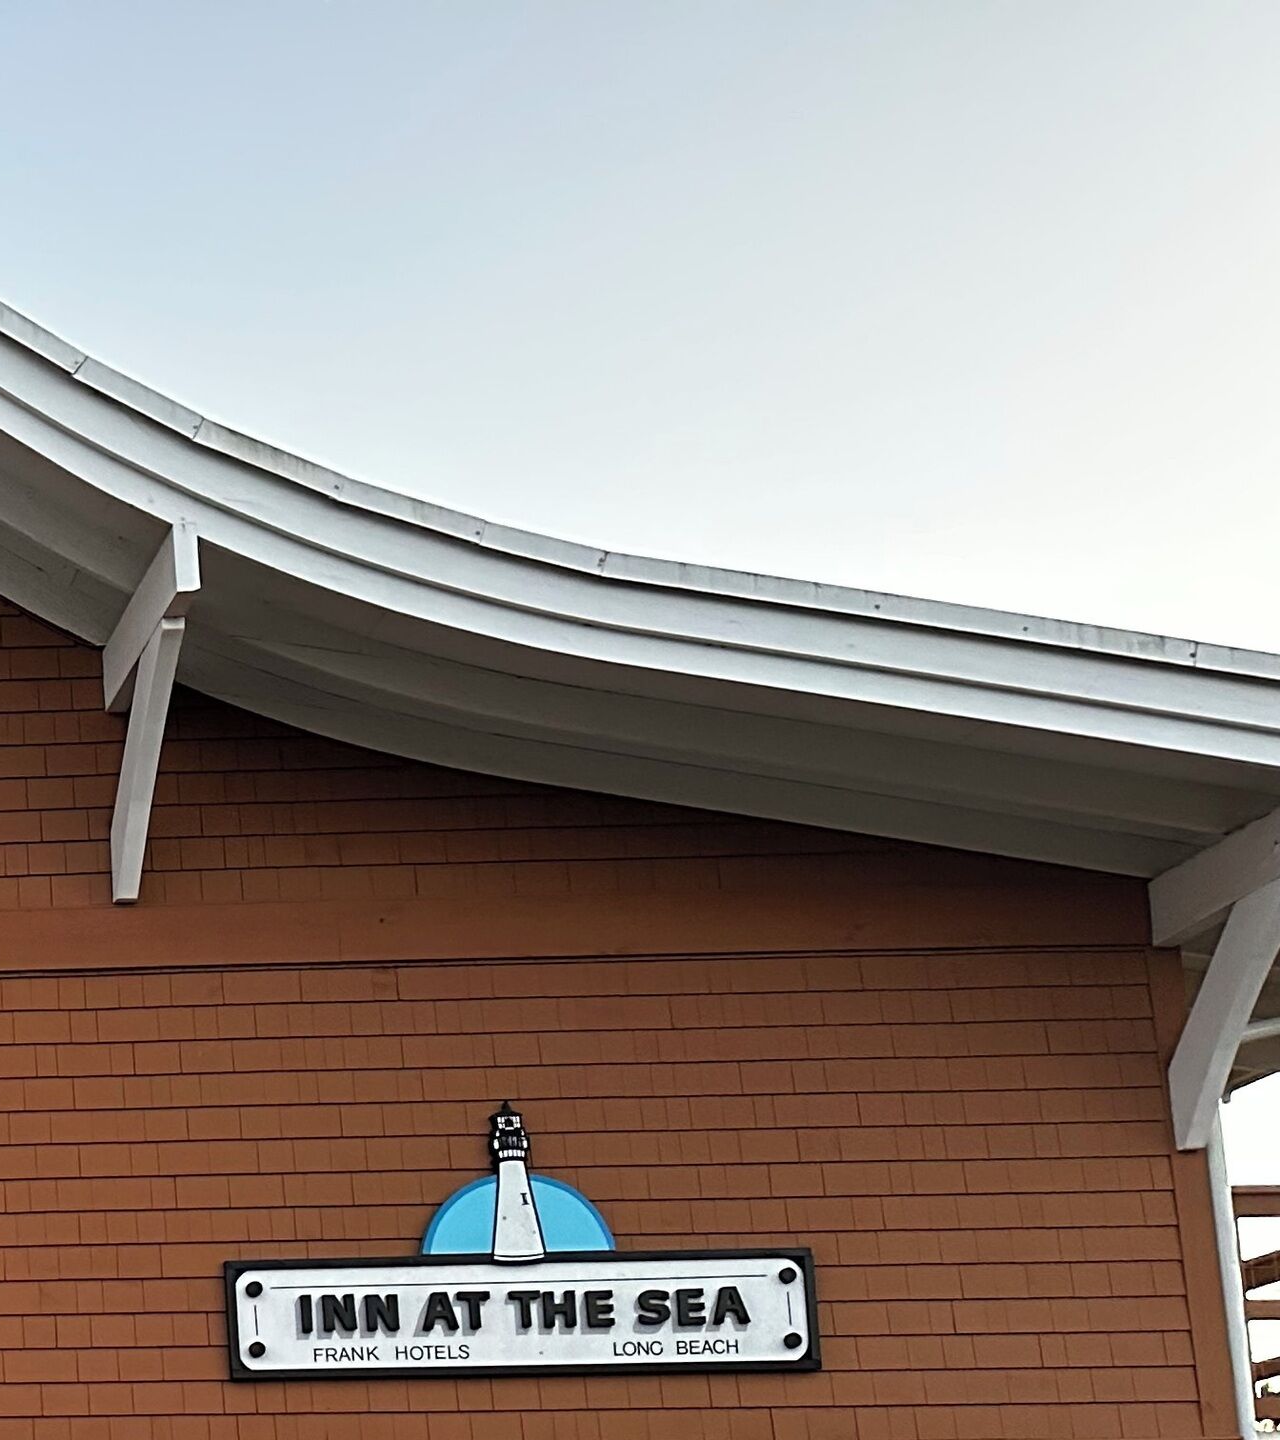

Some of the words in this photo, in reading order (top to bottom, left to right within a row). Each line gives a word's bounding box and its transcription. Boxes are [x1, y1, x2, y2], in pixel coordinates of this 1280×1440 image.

[297, 1293, 400, 1334] INN
[422, 1291, 490, 1331] AT
[507, 1290, 615, 1328] THE
[637, 1286, 751, 1325] SEA
[313, 1346, 380, 1362] FRANK
[395, 1344, 470, 1361] HOTELS
[613, 1341, 663, 1356] LONG
[676, 1339, 739, 1355] BEACH
